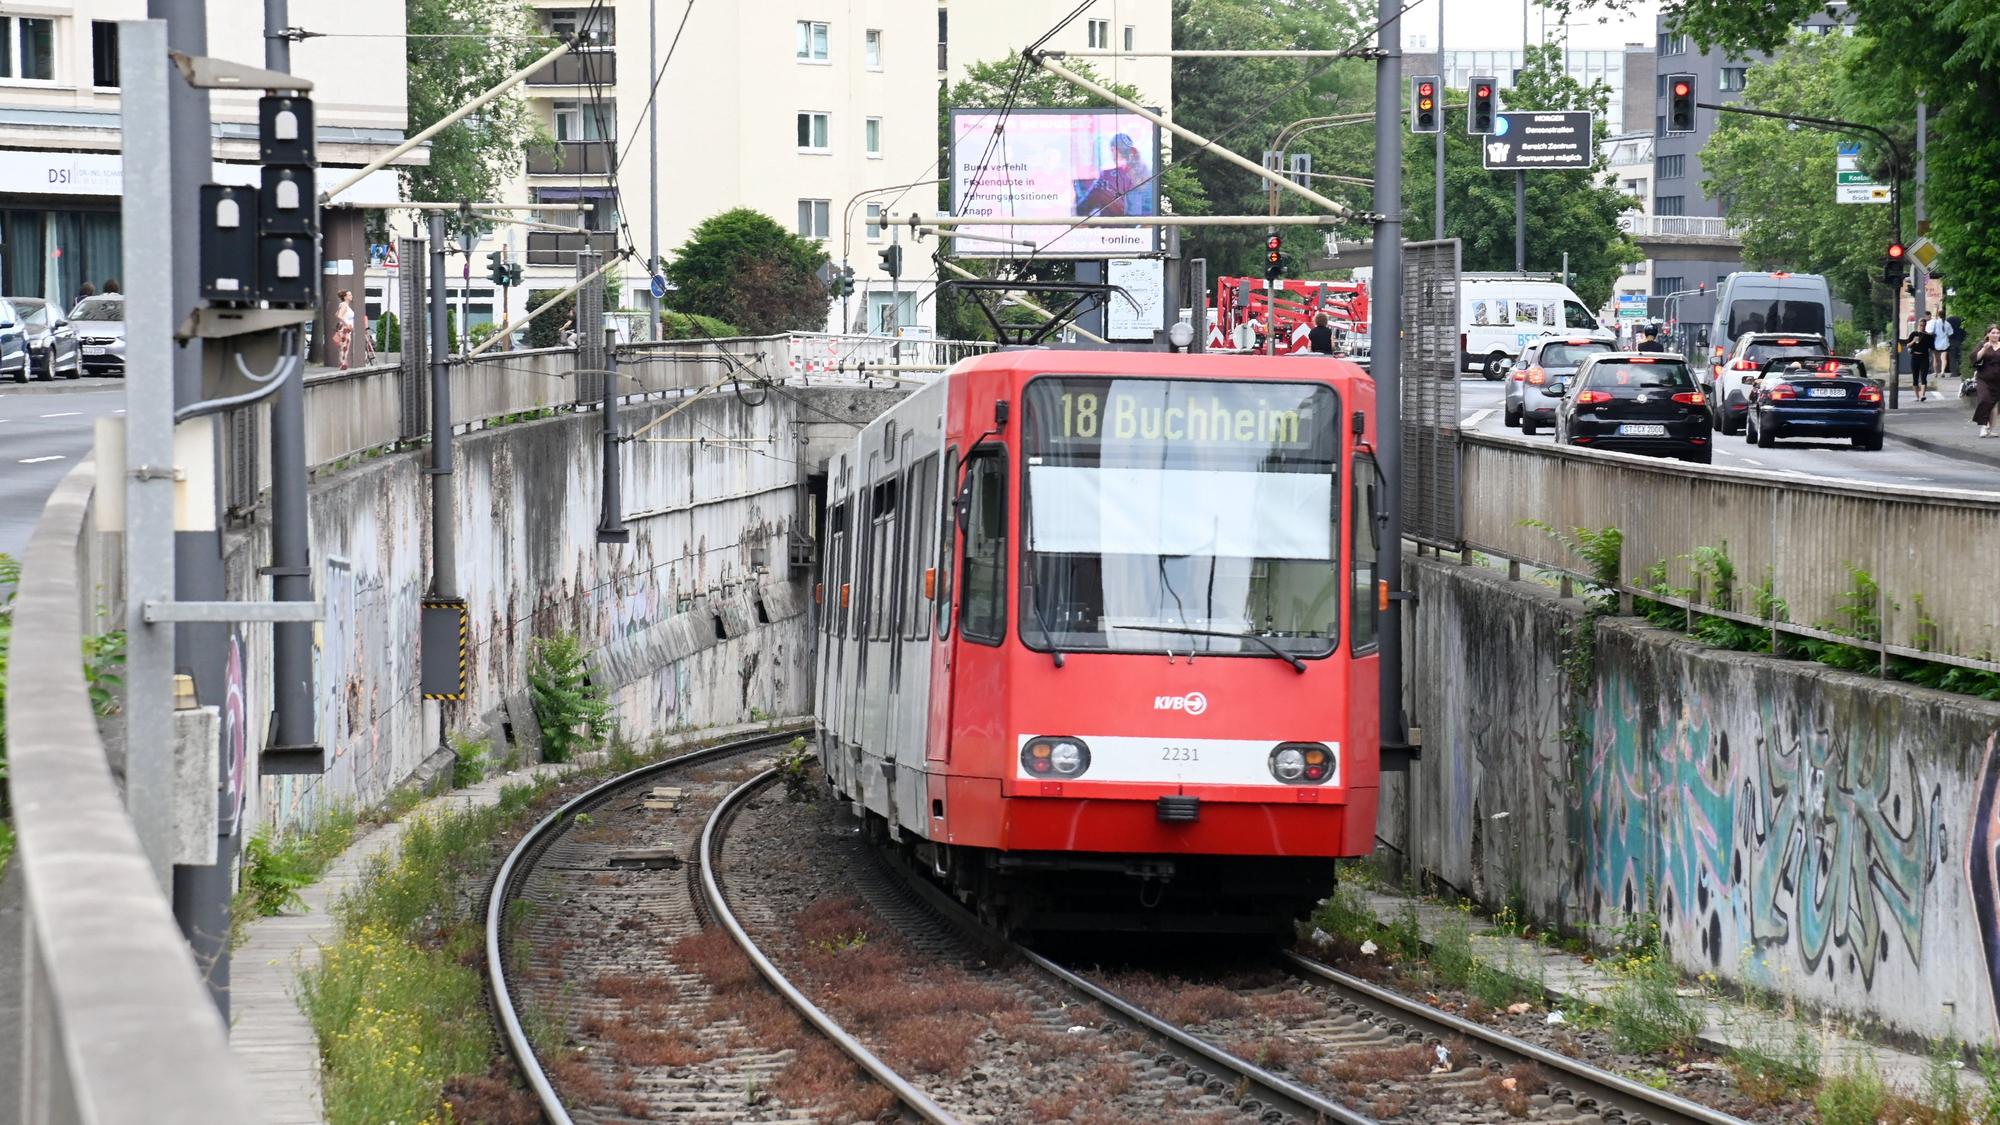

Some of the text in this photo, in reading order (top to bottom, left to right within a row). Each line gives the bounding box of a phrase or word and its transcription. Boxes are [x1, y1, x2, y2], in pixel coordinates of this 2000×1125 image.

[48, 168, 71, 183] DSI
[1025, 178, 1035, 186] in
[1061, 393, 1300, 443] 18 Buchheim
[1153, 695, 1185, 710] KVB
[1161, 747, 1199, 761] 2231
